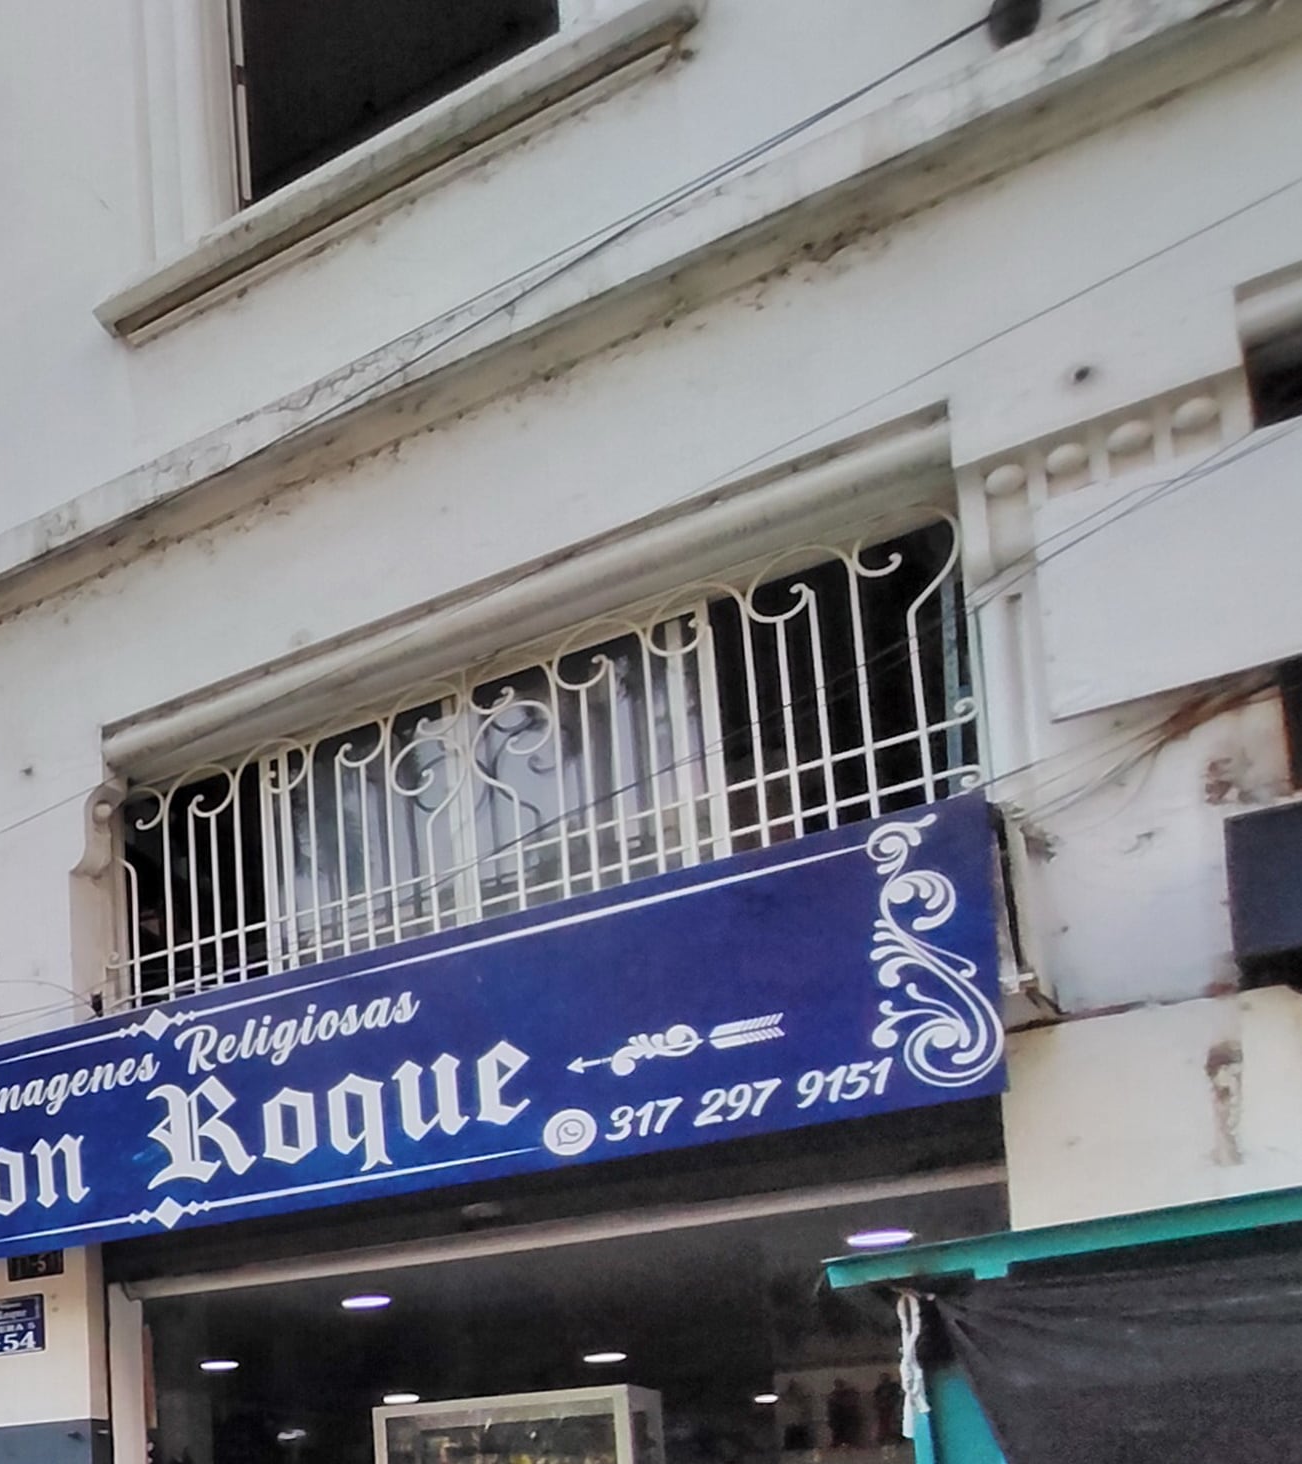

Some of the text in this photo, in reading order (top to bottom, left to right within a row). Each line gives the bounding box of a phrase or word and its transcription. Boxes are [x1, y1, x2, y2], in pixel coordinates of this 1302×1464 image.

[174, 991, 420, 1075] Religiosas
[144, 1039, 531, 1190] Roque
[604, 1057, 893, 1142] 317 297 9151
